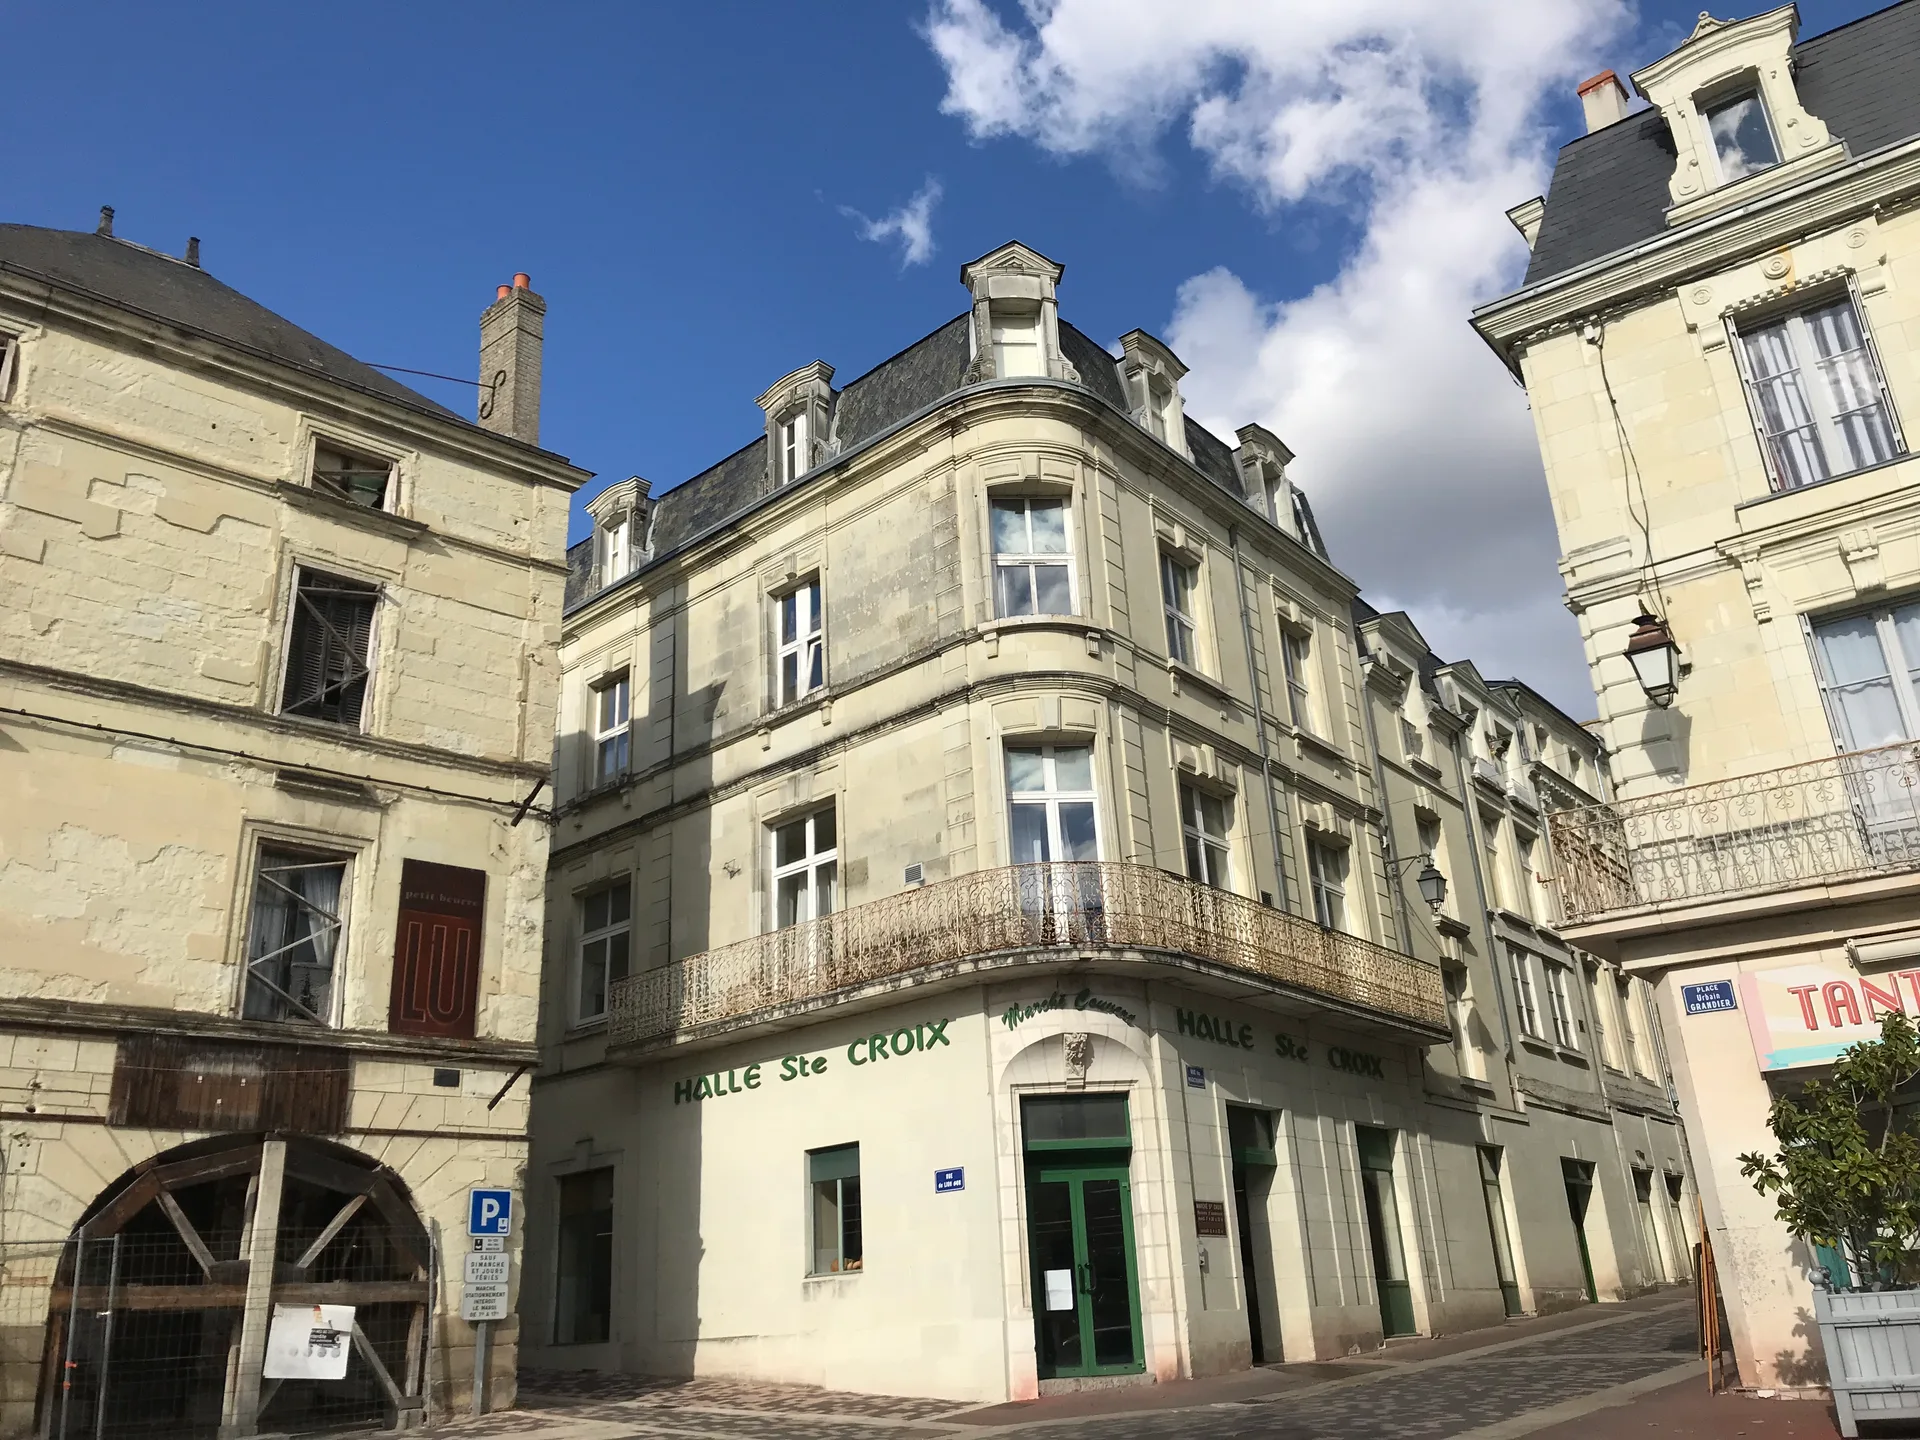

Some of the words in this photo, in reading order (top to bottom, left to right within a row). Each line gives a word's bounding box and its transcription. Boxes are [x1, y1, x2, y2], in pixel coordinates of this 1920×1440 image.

[400, 921, 471, 1026] LU
[1696, 984, 1719, 993] PLACE
[1001, 991, 1066, 1031] Marché
[1690, 999, 1731, 1011] GRANDIER
[1696, 993, 1720, 1001] Urbain
[1176, 1008, 1255, 1049] HALLE
[1275, 1032, 1309, 1062] Ste
[1327, 1046, 1384, 1079] CROIX
[674, 1063, 762, 1105] HALLE
[780, 1055, 828, 1081] Ste
[847, 1018, 951, 1066] CROIX
[481, 1198, 500, 1226] P
